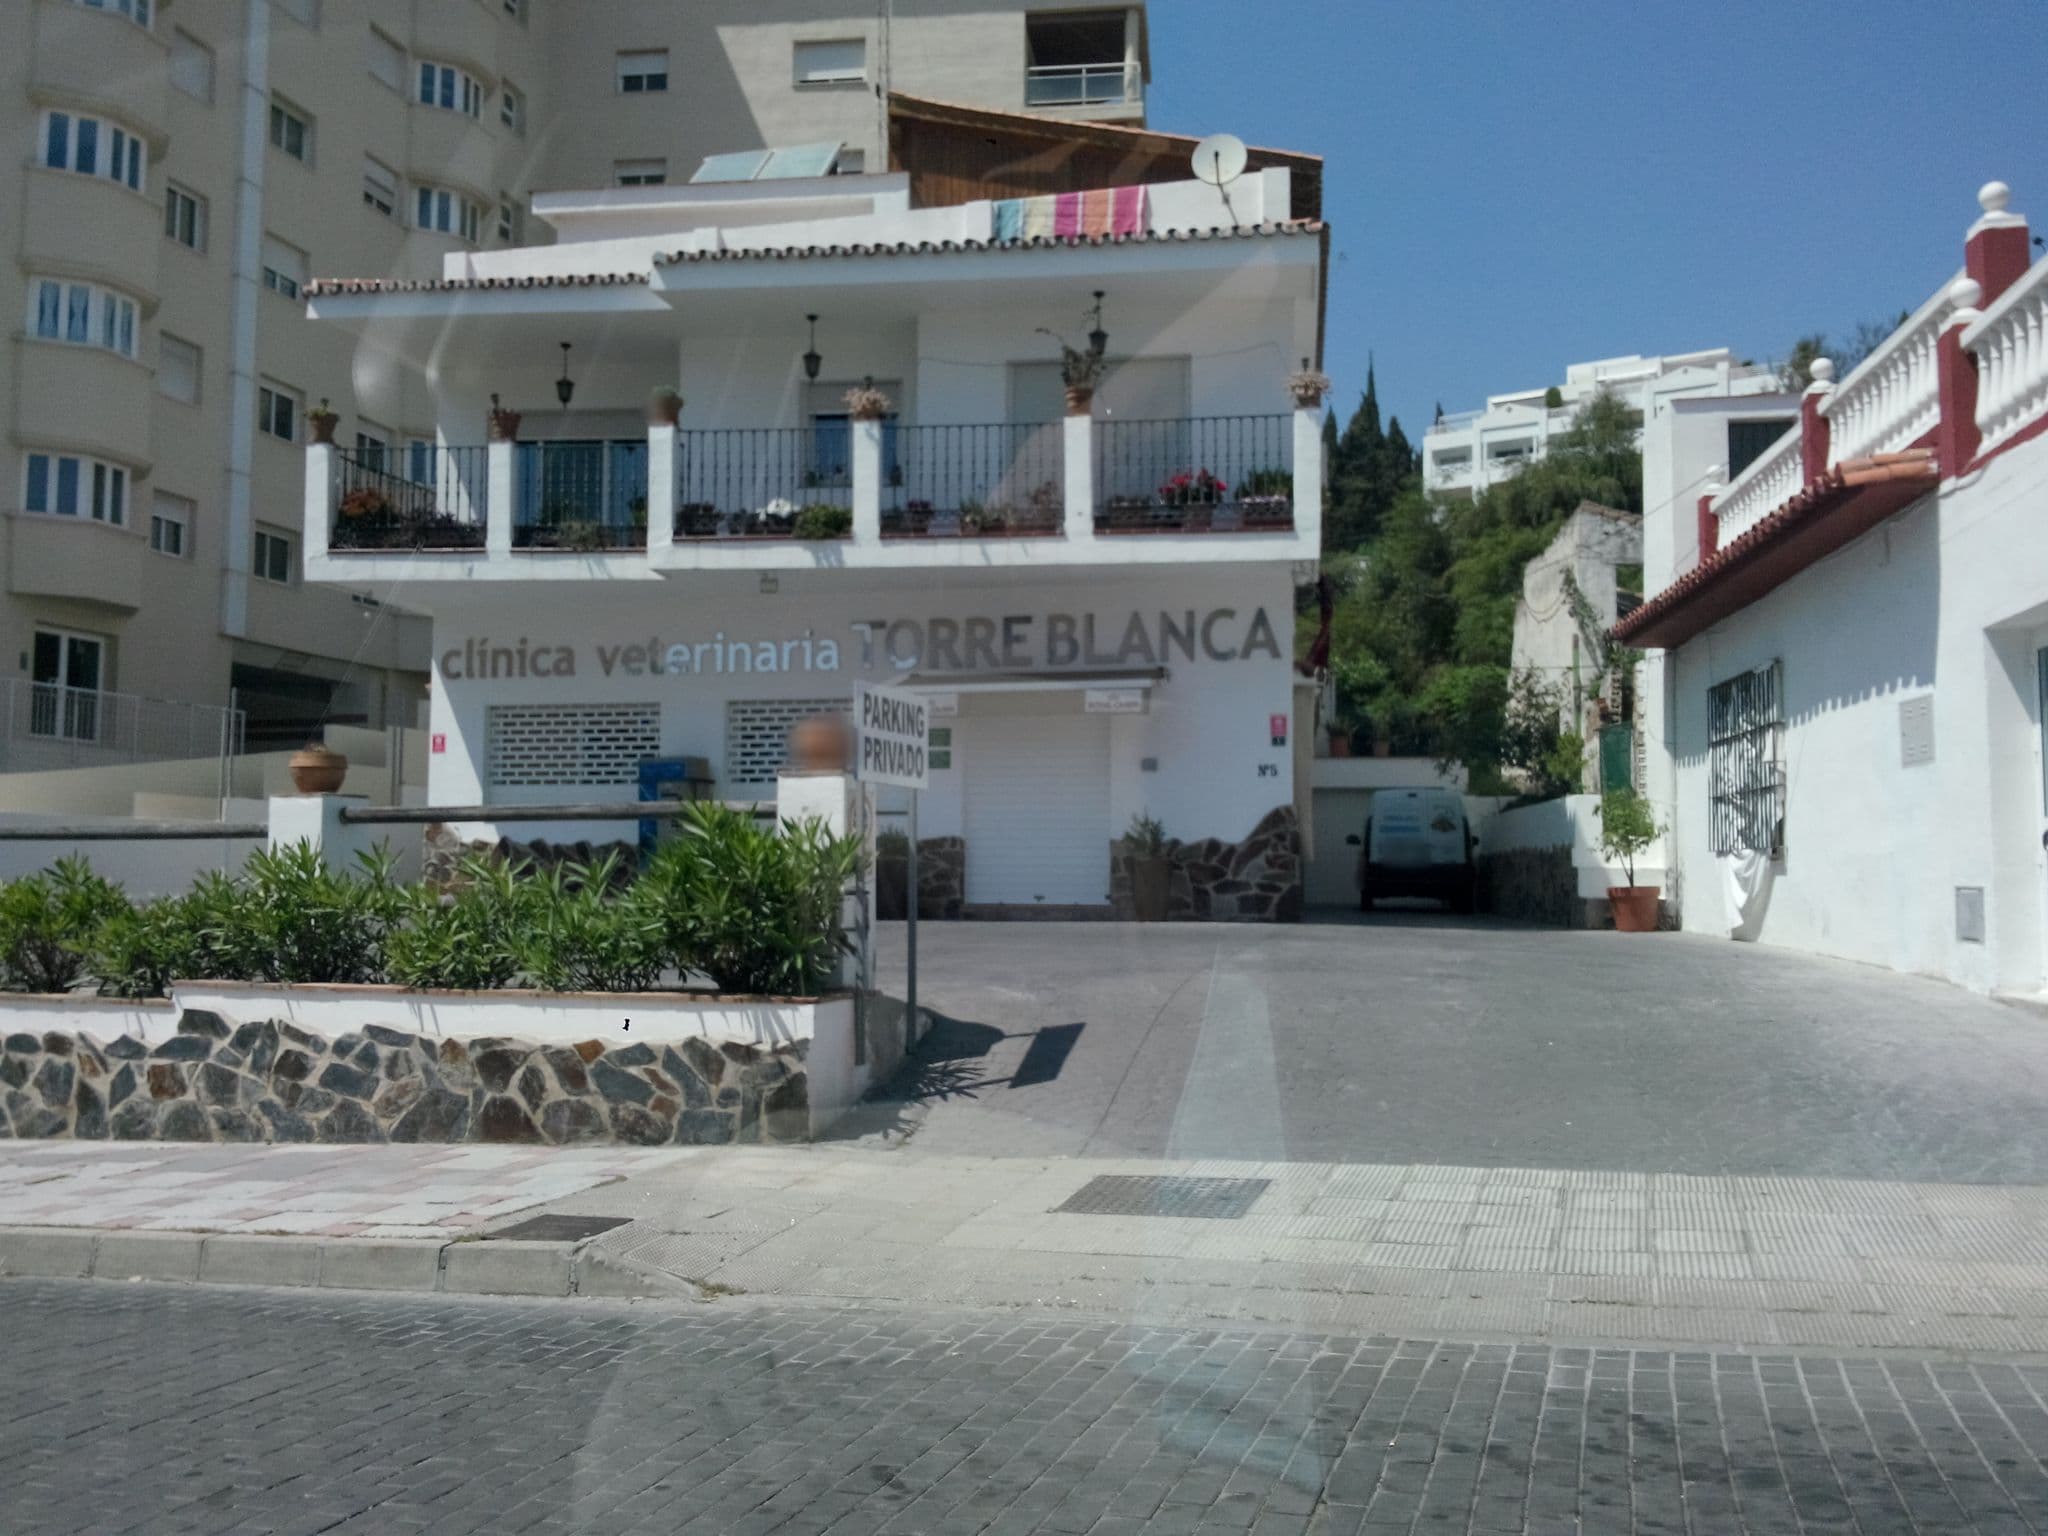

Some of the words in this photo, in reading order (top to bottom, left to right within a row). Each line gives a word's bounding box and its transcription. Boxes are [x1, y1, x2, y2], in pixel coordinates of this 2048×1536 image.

[441, 637, 577, 680] clínica
[596, 632, 840, 676] veterinaria
[852, 615, 1033, 671] TORRE
[1046, 607, 1282, 666] BLANCA
[862, 692, 925, 739] PARKING
[863, 736, 924, 779] PRIVADO
